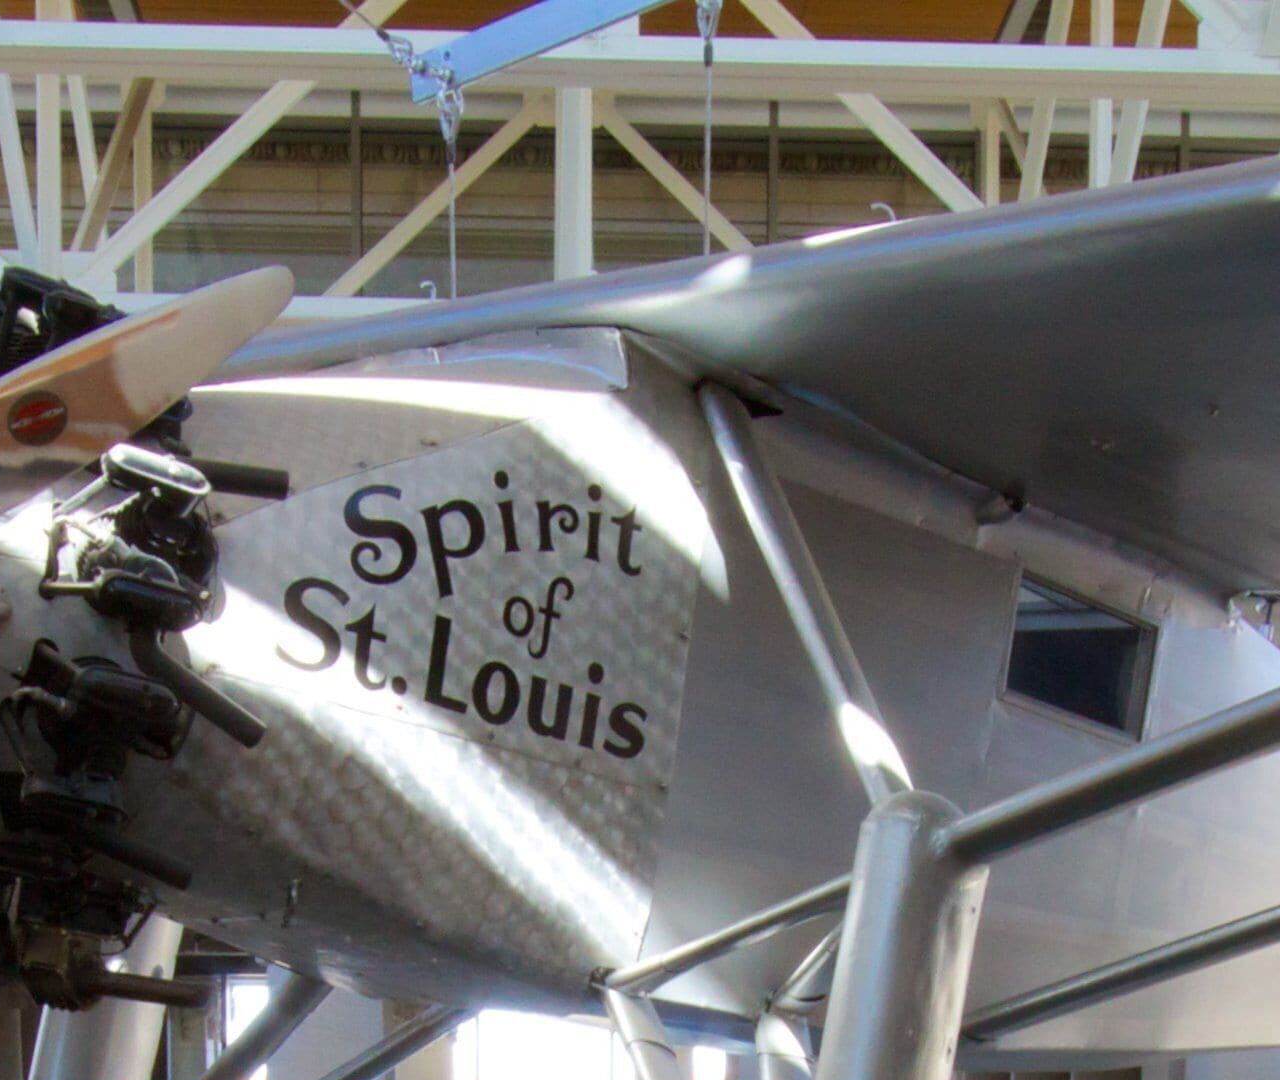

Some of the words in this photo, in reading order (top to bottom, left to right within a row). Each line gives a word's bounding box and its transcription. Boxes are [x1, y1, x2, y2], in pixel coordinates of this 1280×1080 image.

[343, 470, 642, 598] Spirit
[276, 577, 407, 690] St.
[424, 615, 648, 759] Louis
[503, 576, 575, 660] of
